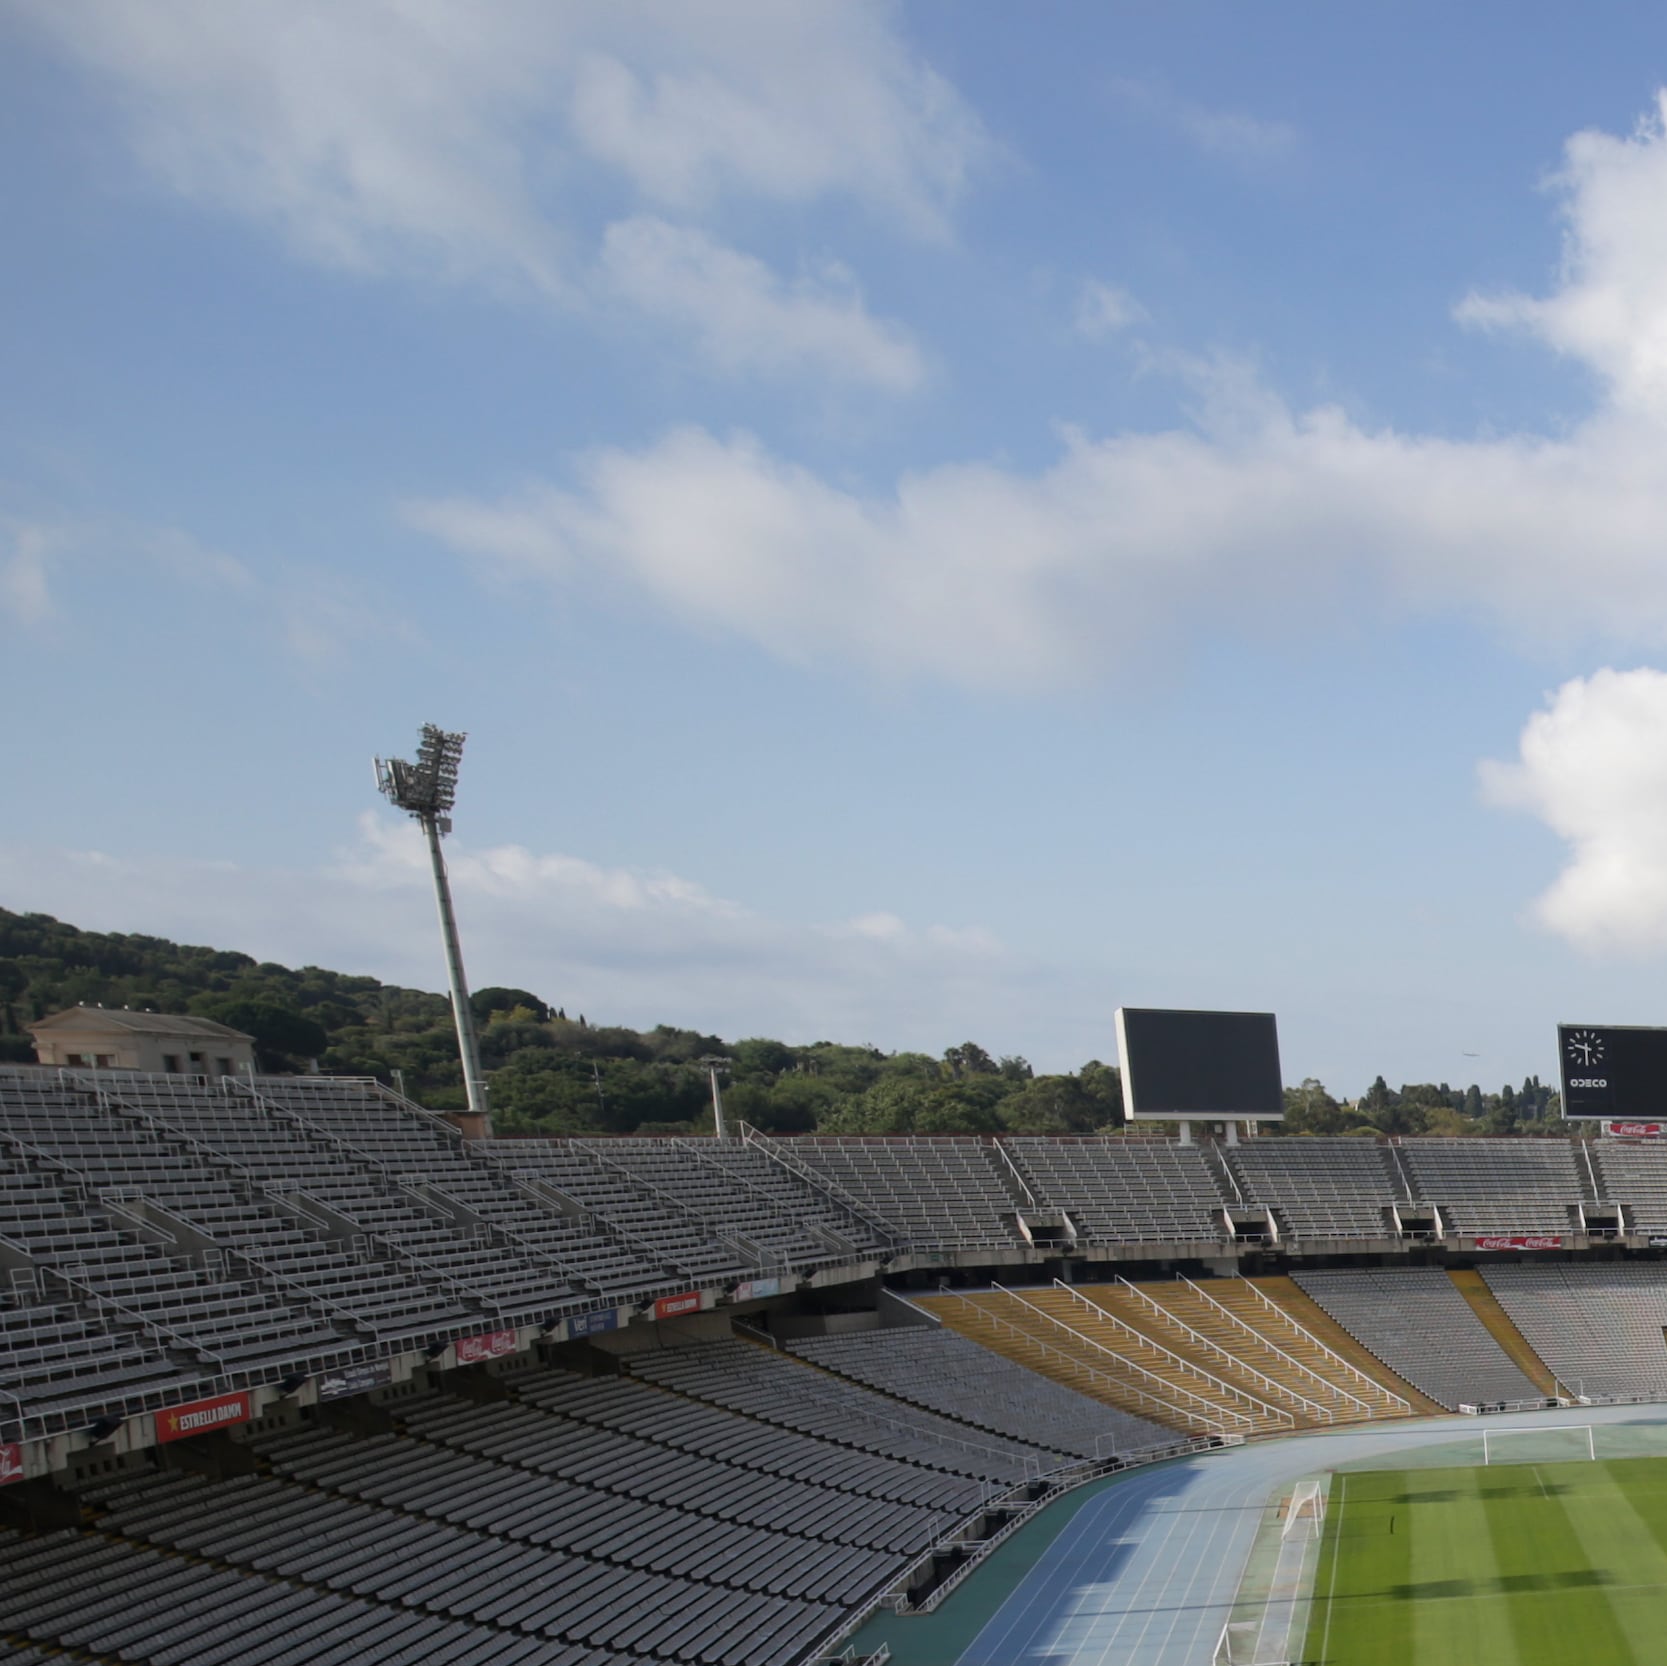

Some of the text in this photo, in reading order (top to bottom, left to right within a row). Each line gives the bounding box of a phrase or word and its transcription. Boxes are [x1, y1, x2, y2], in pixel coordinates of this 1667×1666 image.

[1570, 1079, 1607, 1088] ODECO
[180, 1402, 242, 1431] ESTRELLA DAMM
